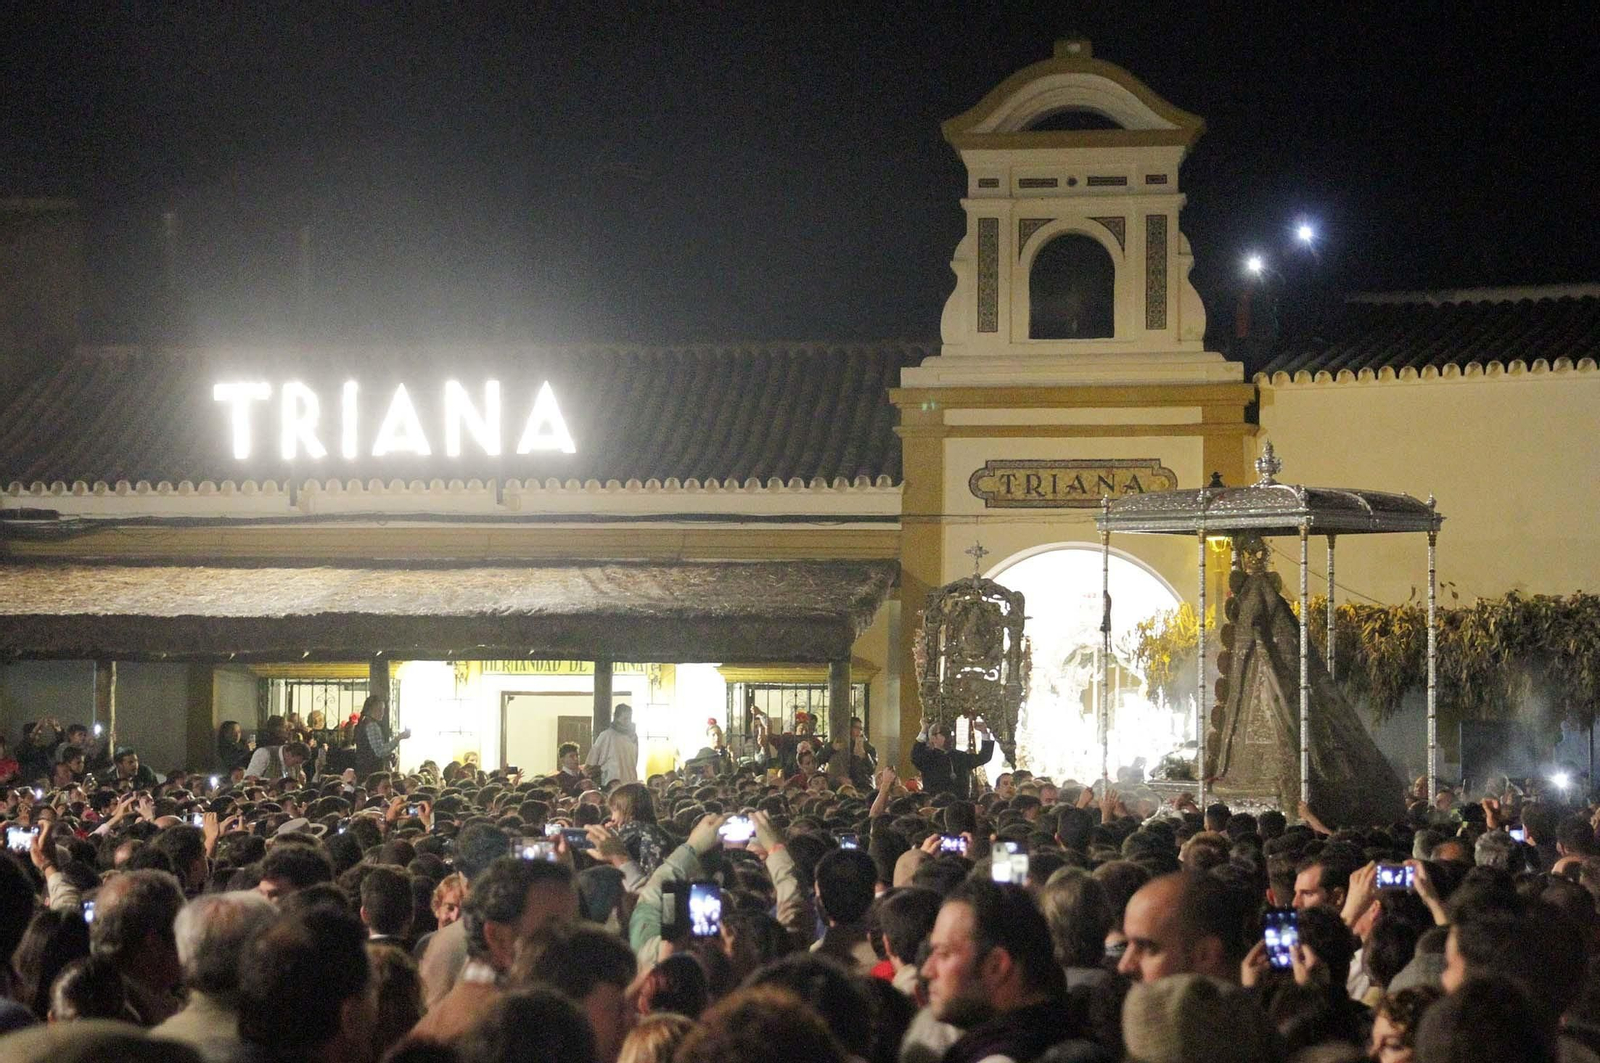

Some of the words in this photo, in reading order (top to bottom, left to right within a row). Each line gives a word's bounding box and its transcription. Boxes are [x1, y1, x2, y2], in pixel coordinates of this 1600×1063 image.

[213, 380, 577, 460] TRIANA
[998, 473, 1146, 497] TRIANA
[568, 660, 588, 672] DE
